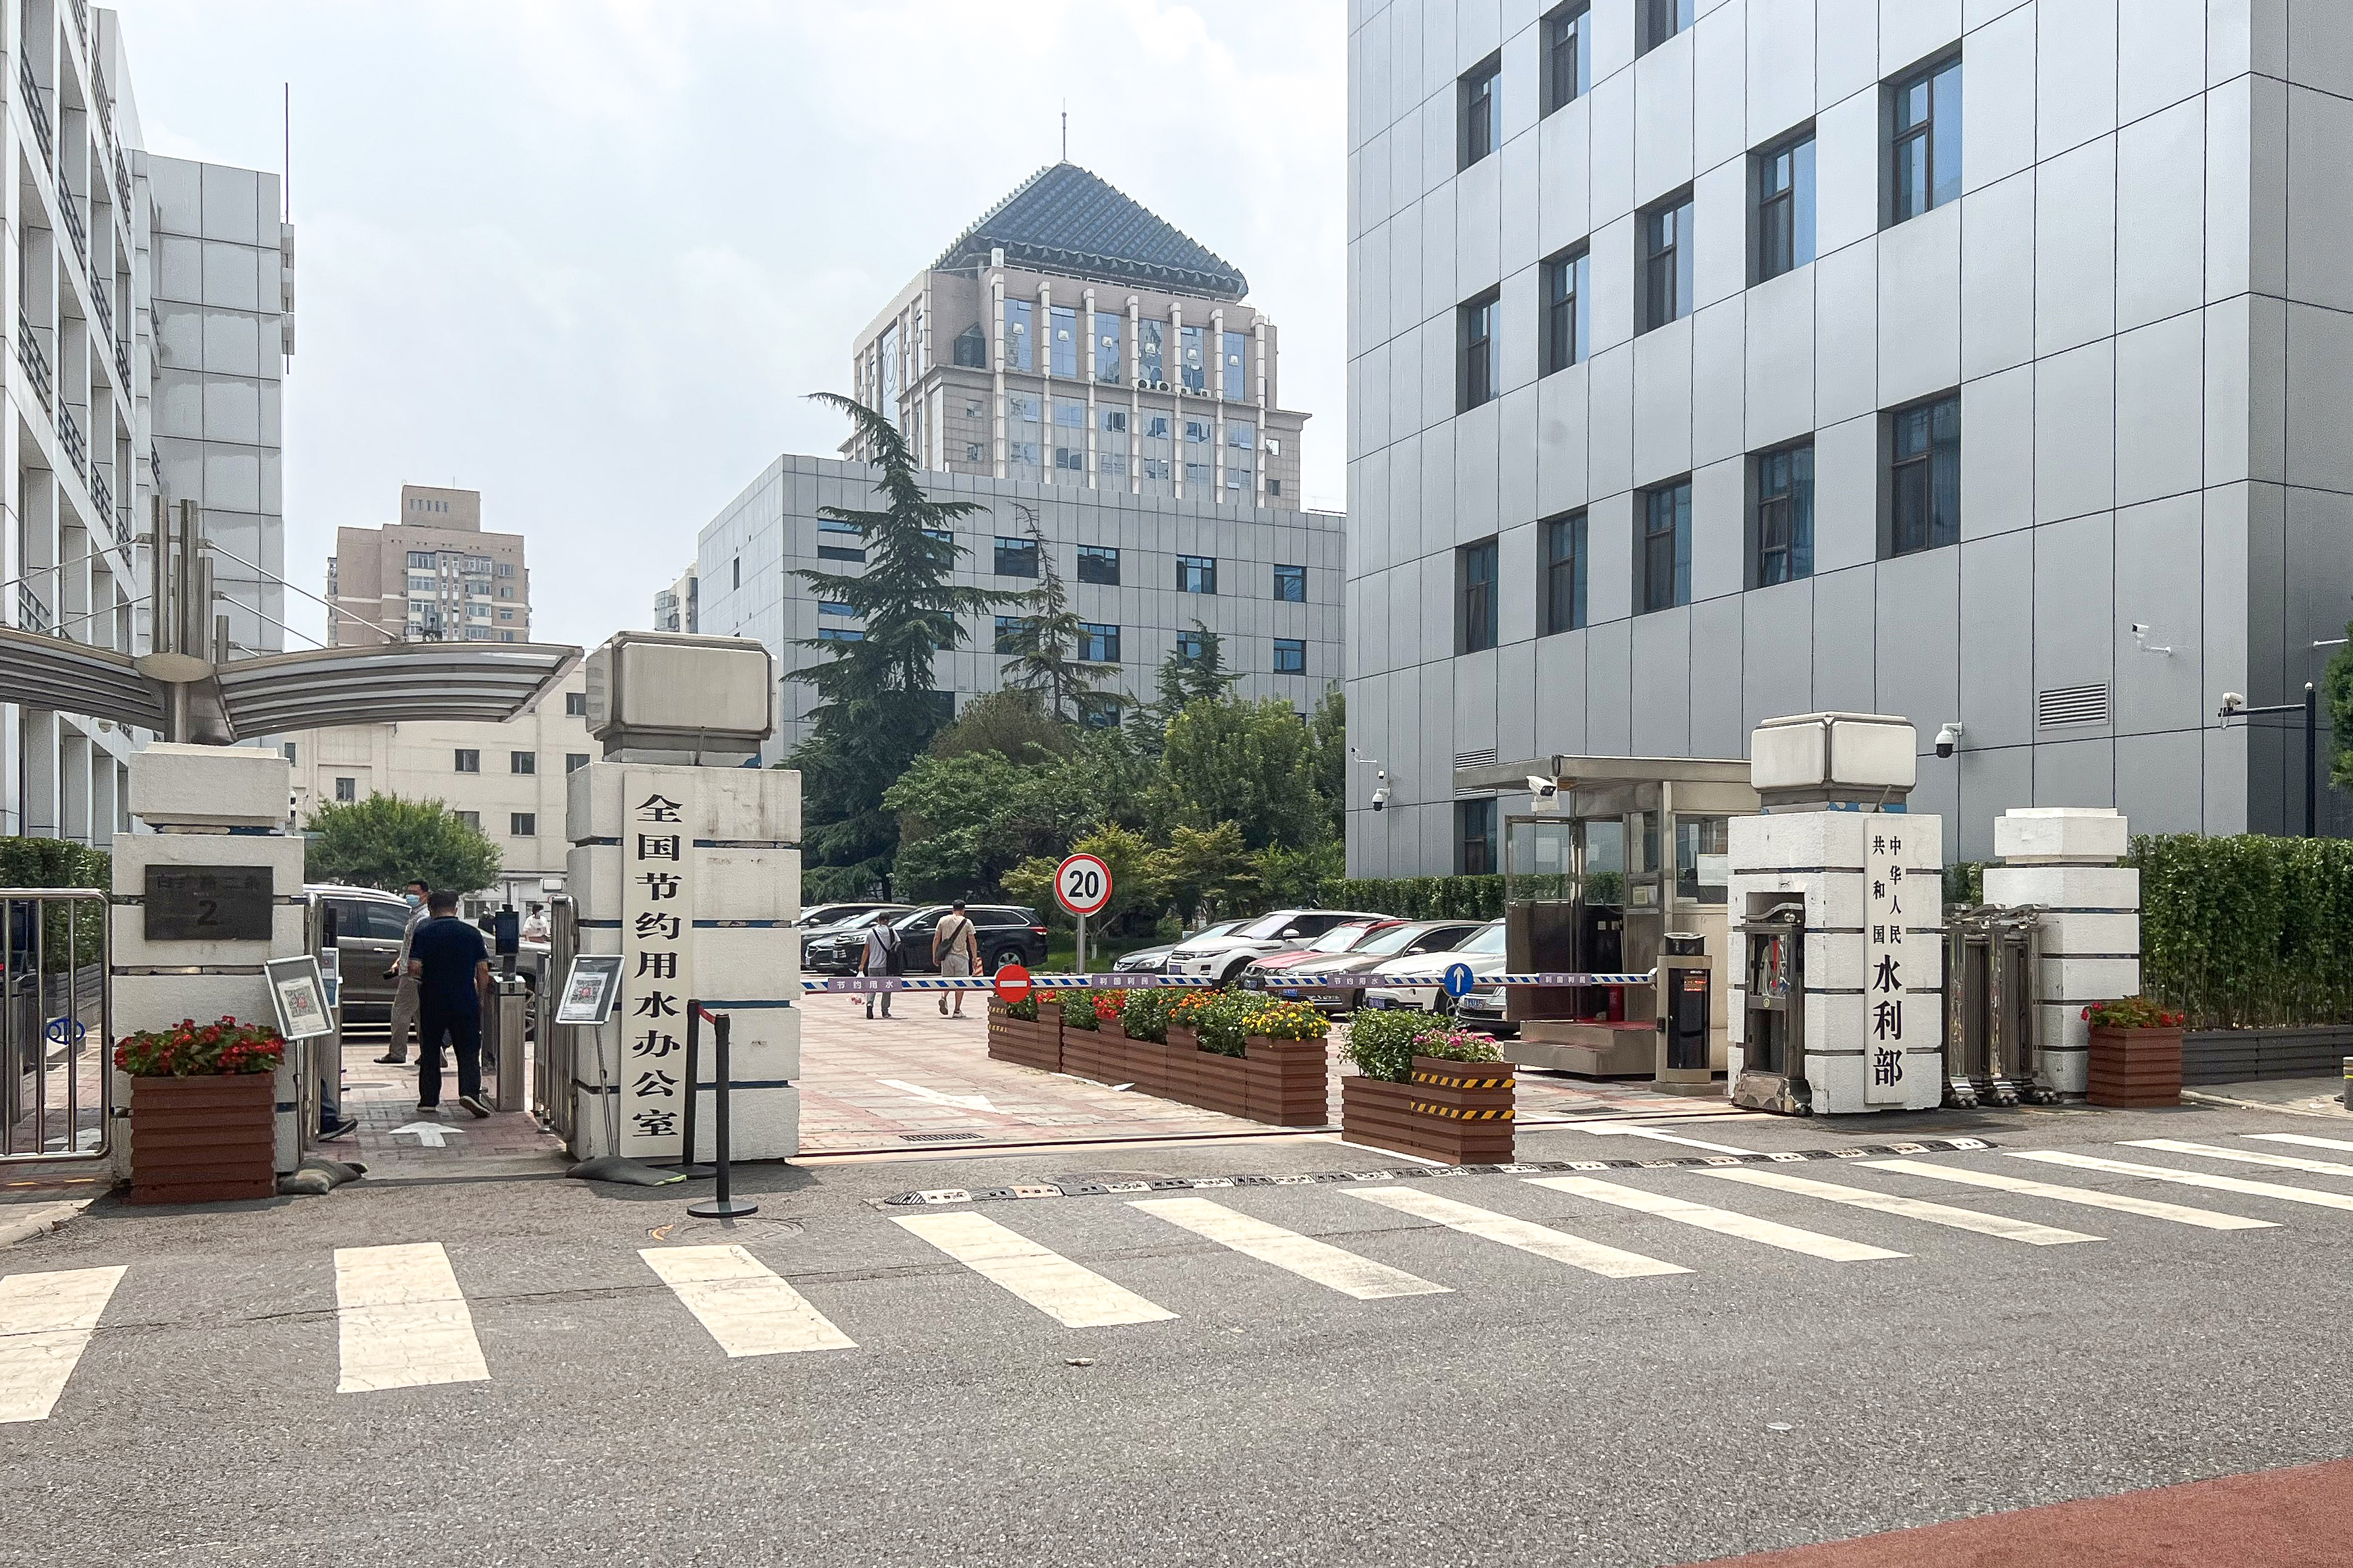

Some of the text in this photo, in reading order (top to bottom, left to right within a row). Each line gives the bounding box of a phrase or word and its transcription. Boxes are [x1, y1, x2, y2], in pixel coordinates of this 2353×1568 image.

[197, 900, 218, 926] 2
[1068, 870, 1099, 899] 20
[1873, 835, 1885, 944] 共和国
[1889, 835, 1902, 944] 中华人民
[631, 794, 684, 1138] 全国节约用水办公室
[836, 979, 894, 990] 节约用水
[1873, 954, 1903, 1087] 水利部
